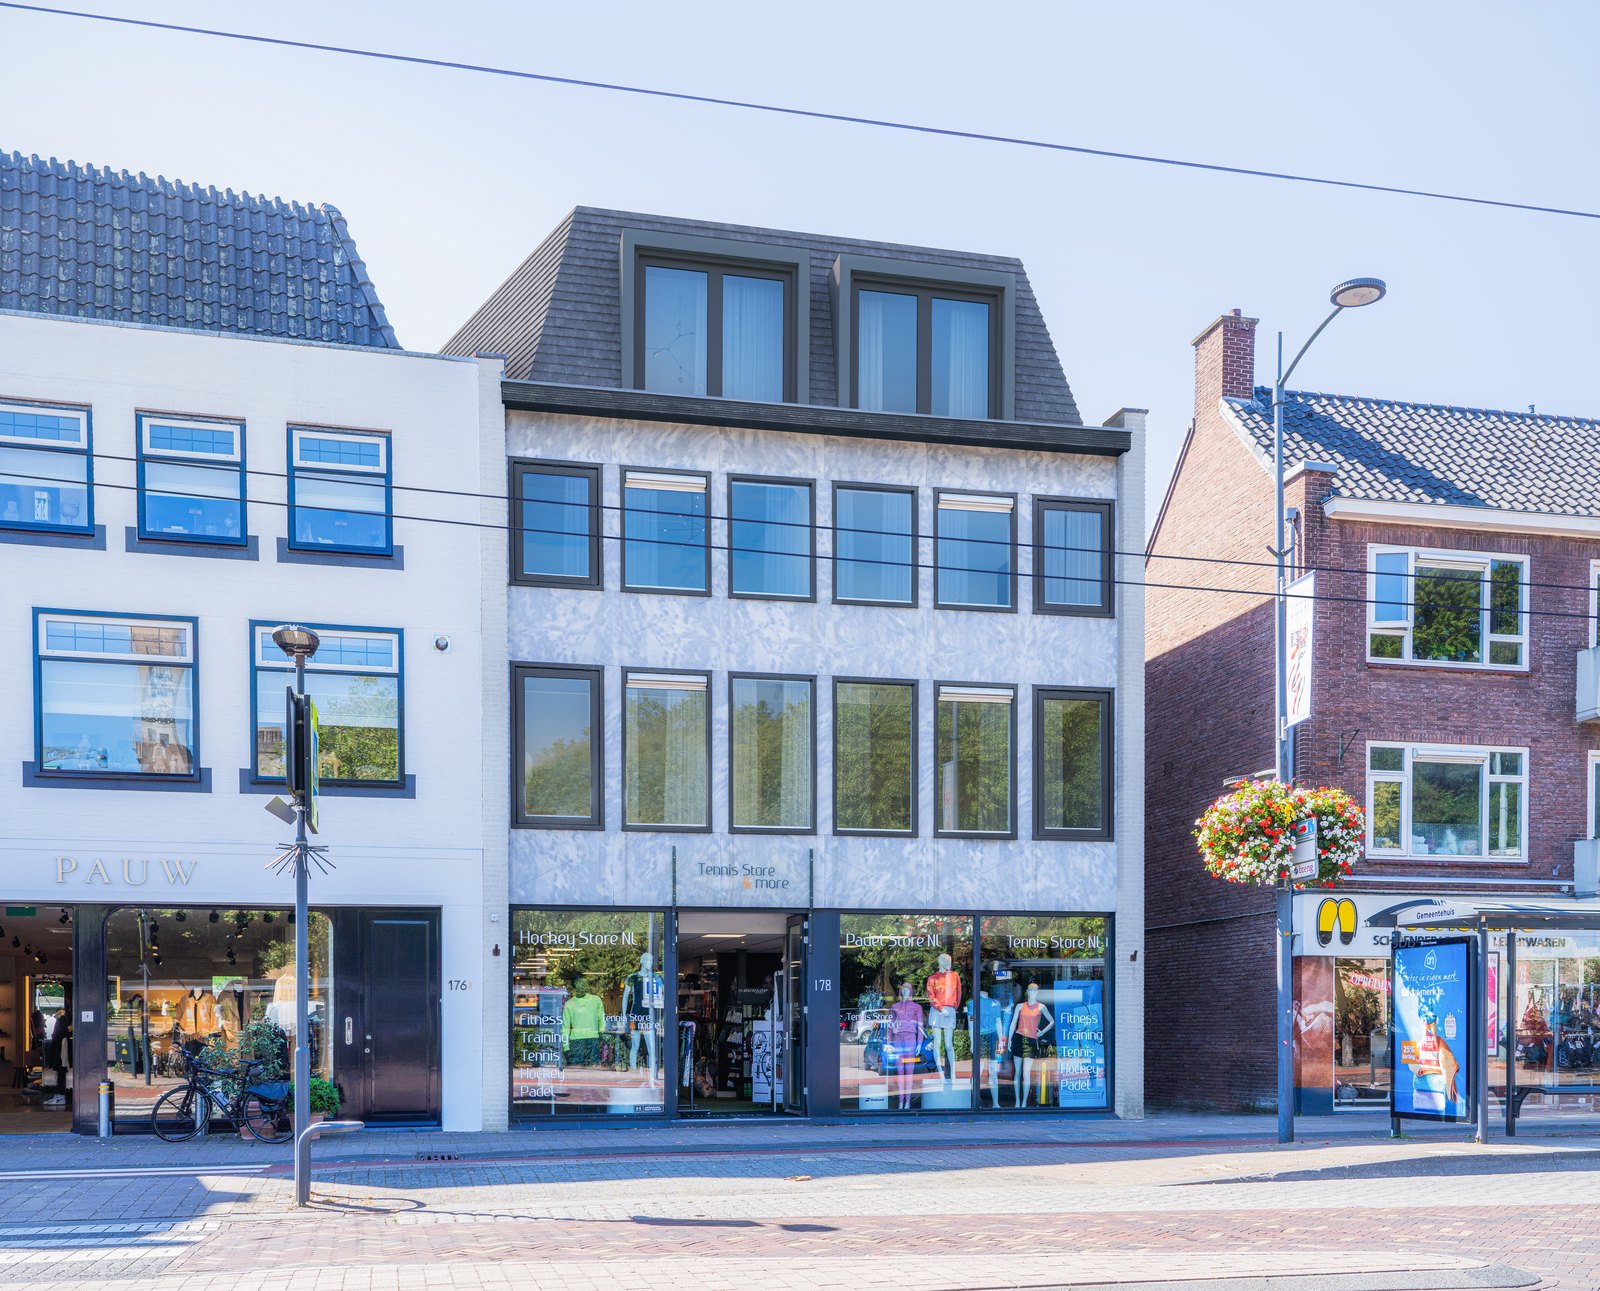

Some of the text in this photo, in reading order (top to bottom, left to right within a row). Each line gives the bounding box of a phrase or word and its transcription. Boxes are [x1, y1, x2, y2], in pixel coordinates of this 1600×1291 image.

[56, 855, 198, 885] PAUW
[698, 863, 776, 876] Tennis Store
[742, 877, 790, 889] & more
[1416, 908, 1455, 920] Gemeentehuis
[519, 930, 575, 948] Hockey
[579, 931, 619, 946] Store
[846, 933, 884, 947] Padel
[889, 933, 925, 947] Store
[1006, 935, 1048, 949] Tennis
[1051, 935, 1085, 949] Store
[448, 979, 468, 991] 176
[814, 979, 832, 991] 178
[519, 1013, 563, 1026] Fitness
[602, 1013, 651, 1023] Tennis Store
[846, 1012, 894, 1021] Tennis Store
[1060, 1012, 1098, 1024] Fitness
[637, 1022, 660, 1030] more
[880, 1020, 902, 1029] more
[520, 1031, 569, 1046] Training
[1061, 1029, 1103, 1043] Training
[521, 1049, 560, 1062] Tennis
[1061, 1046, 1095, 1058] Tennis
[519, 1067, 565, 1081] Hockey
[1060, 1062, 1099, 1075] Hockey
[520, 1085, 555, 1098] Padel
[1060, 1079, 1091, 1091] Padel
